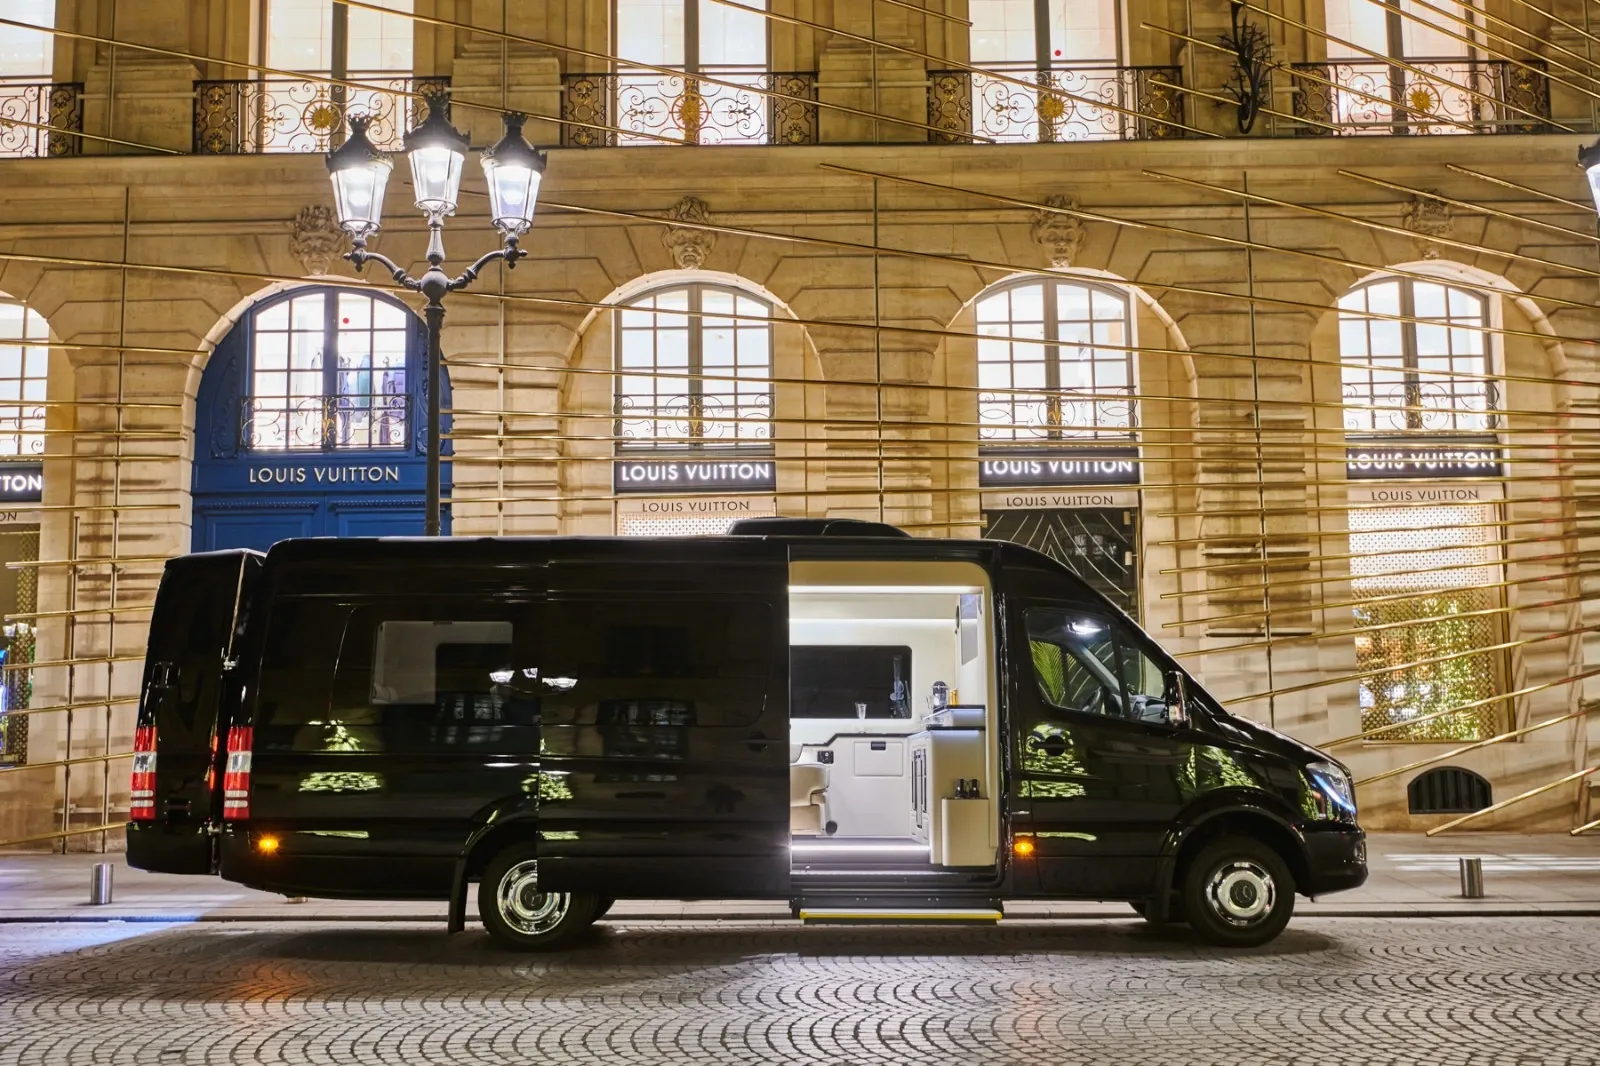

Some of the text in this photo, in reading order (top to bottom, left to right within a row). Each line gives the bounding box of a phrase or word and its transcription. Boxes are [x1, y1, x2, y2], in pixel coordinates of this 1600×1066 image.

[984, 460, 1042, 475] LOUIS
[1348, 451, 1496, 470] LOUIS VUITTON
[249, 465, 400, 484] LOUIS VUITTON
[621, 463, 770, 482] LOUIS VUITTON
[1006, 495, 1114, 507] LOUIS VUITTON
[1371, 489, 1479, 501] LOUIS VUITTON
[642, 501, 750, 513] LOUIS VUITTON
